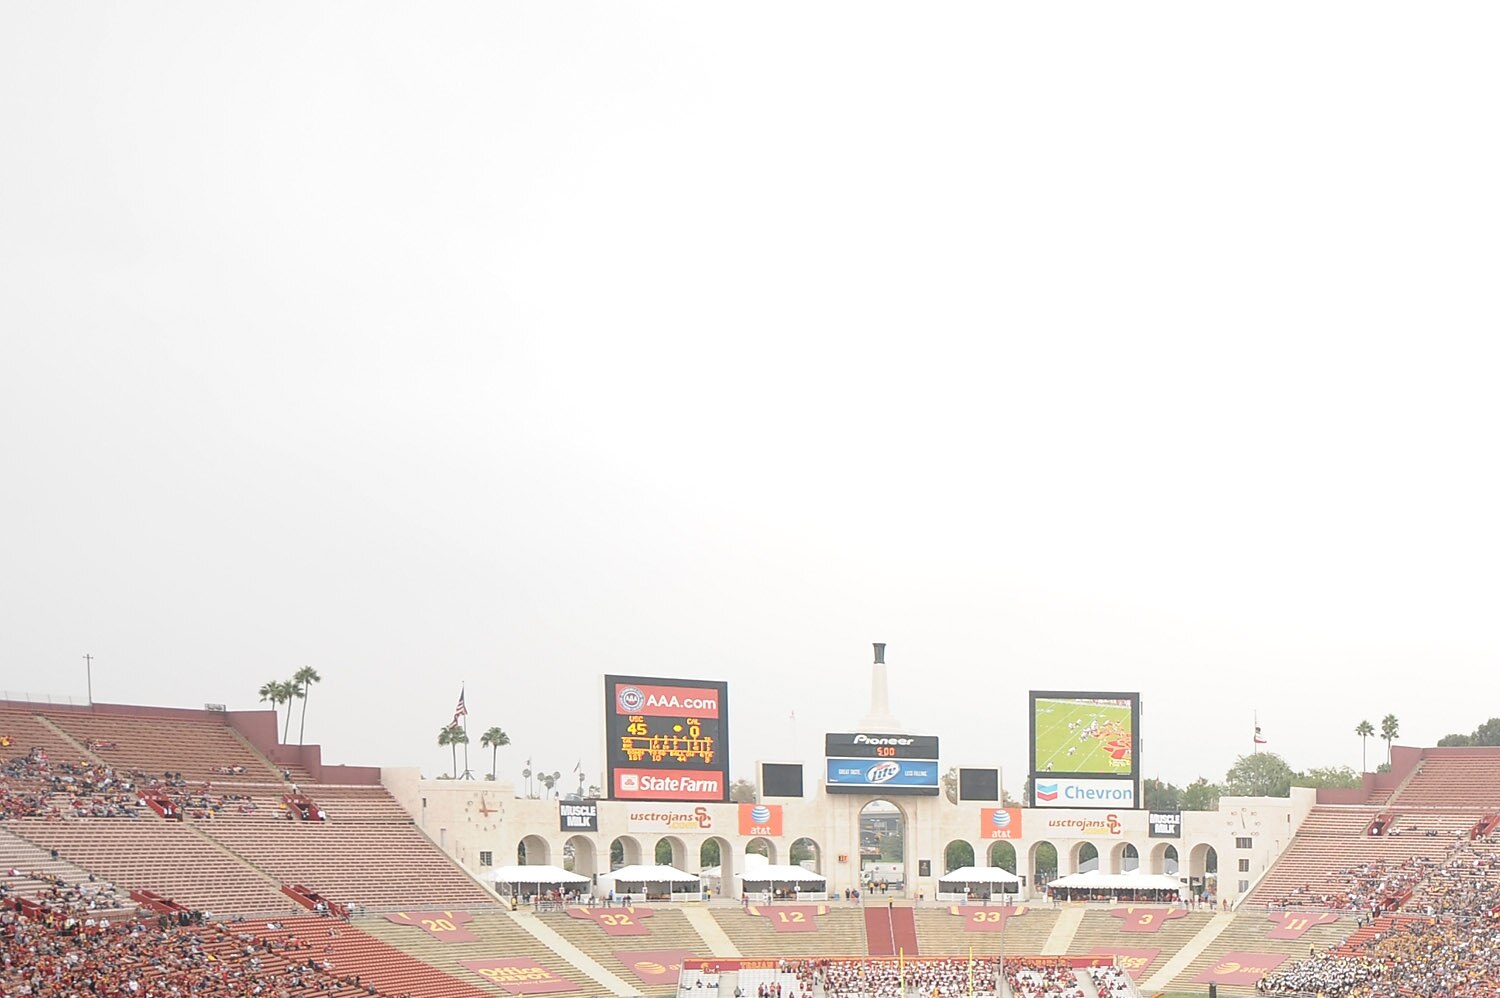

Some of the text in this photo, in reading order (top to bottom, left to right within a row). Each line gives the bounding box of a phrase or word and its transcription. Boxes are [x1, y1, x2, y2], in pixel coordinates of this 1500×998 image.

[646, 694, 717, 710] AAA.com
[627, 723, 648, 736] 45
[689, 725, 701, 738] 0
[853, 734, 914, 746] Pioneer
[1065, 786, 1132, 800] Chevron
[560, 805, 596, 816] MUSCLE
[566, 816, 591, 827] MILK
[630, 811, 694, 825] usctrojans
[1048, 818, 1105, 831] usctrojans
[1150, 813, 1180, 824] MUSCLE
[750, 826, 771, 835] at&t
[991, 830, 1011, 838] at&t
[1154, 823, 1176, 834] MILK
[600, 912, 629, 926] 32
[778, 910, 805, 923] 12
[972, 911, 1001, 923] 33
[1138, 913, 1153, 926] 3
[423, 918, 458, 931] 20
[478, 966, 545, 977] Office
